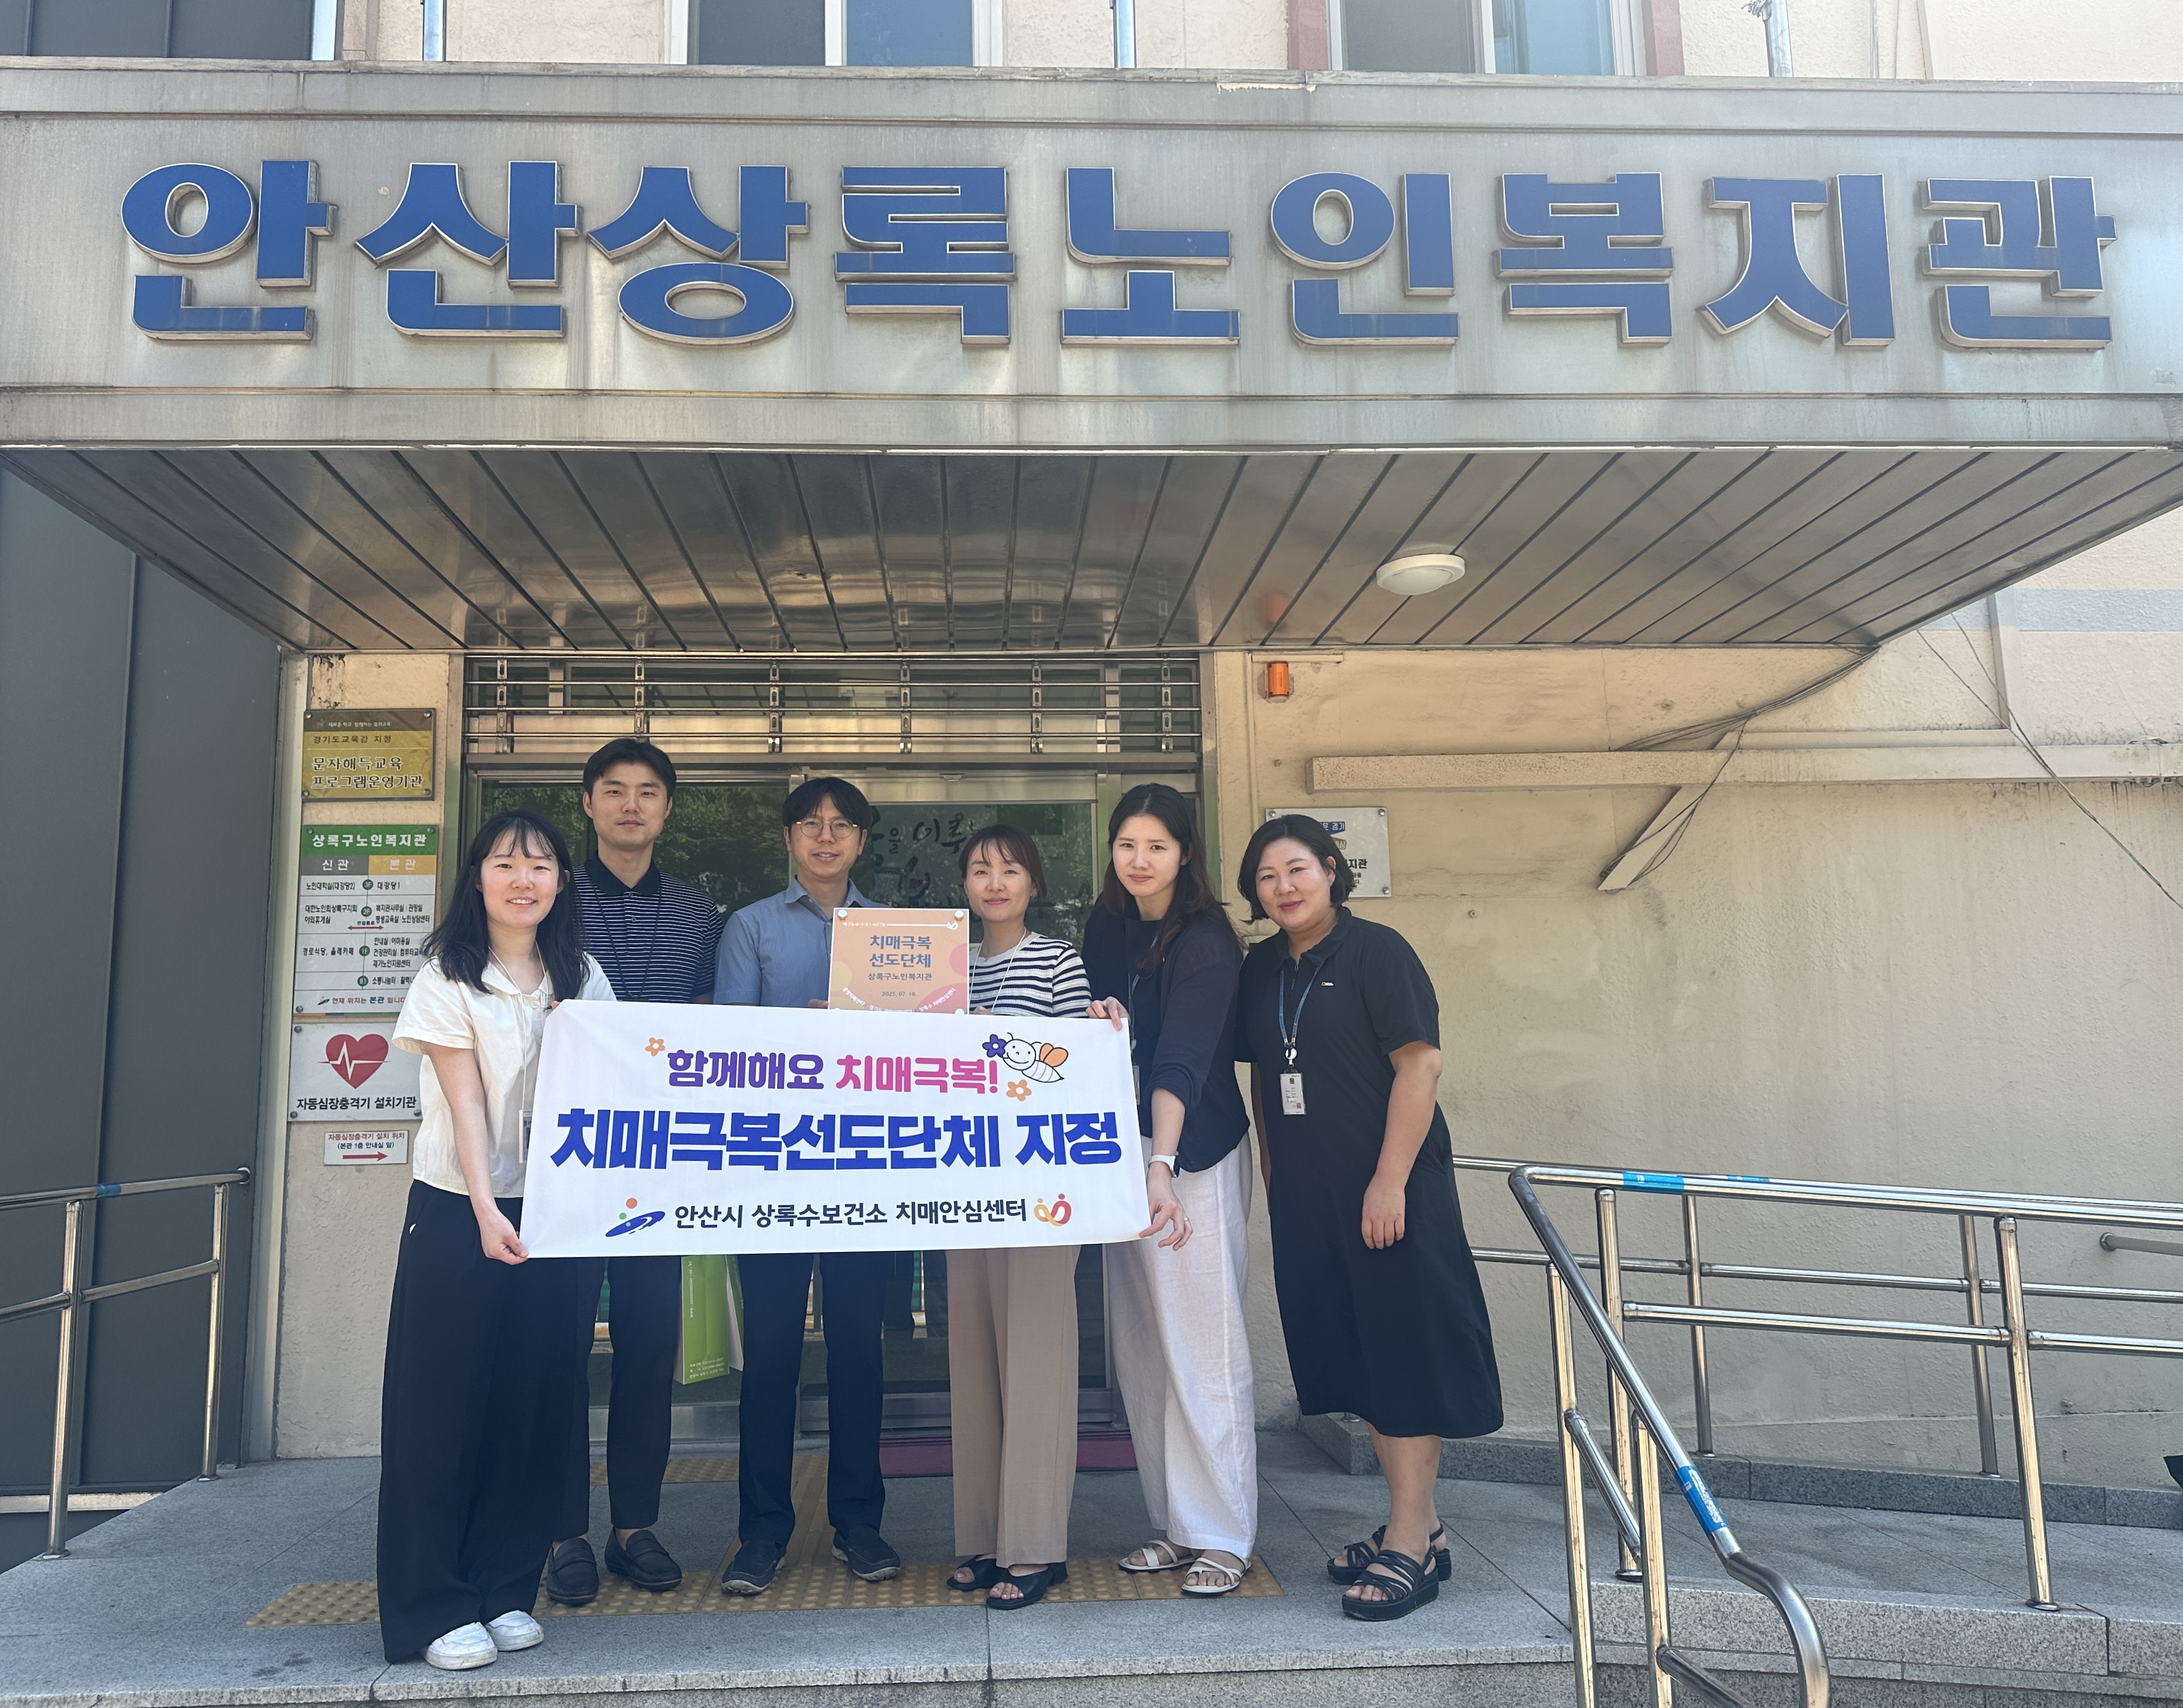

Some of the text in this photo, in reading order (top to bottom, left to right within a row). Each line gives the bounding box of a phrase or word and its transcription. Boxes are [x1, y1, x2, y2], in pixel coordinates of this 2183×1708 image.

[122, 159, 2115, 348] 안산상록노인복지관
[314, 735, 391, 743] 경기도교육감 지정
[312, 756, 403, 771] 문자해득교육
[311, 775, 423, 790] 프로그램운영기관
[1332, 822, 1344, 831] 경기
[312, 834, 427, 847] 상록구노인복지관
[1345, 859, 1368, 869] 지관
[305, 904, 358, 913] 대한노인회상록구지회
[376, 904, 404, 913] 복지관사무실
[304, 916, 331, 924] 야외휴게실
[402, 915, 430, 924] 노인상담센터
[374, 937, 389, 946] 안내실
[870, 935, 932, 950] 치매극복
[373, 959, 411, 968] 재가노인지원센터
[869, 953, 931, 968] 선도단체
[868, 973, 932, 981] 상록구노인복지관
[668, 1050, 999, 1094] 함께해요 치매극복!
[297, 1096, 417, 1110] 자동심장충격기 설치기관
[551, 1108, 1123, 1171] 치매극복선도단체 지정
[674, 1198, 1027, 1229] 안산시 상록수보건소 치매안심센터
